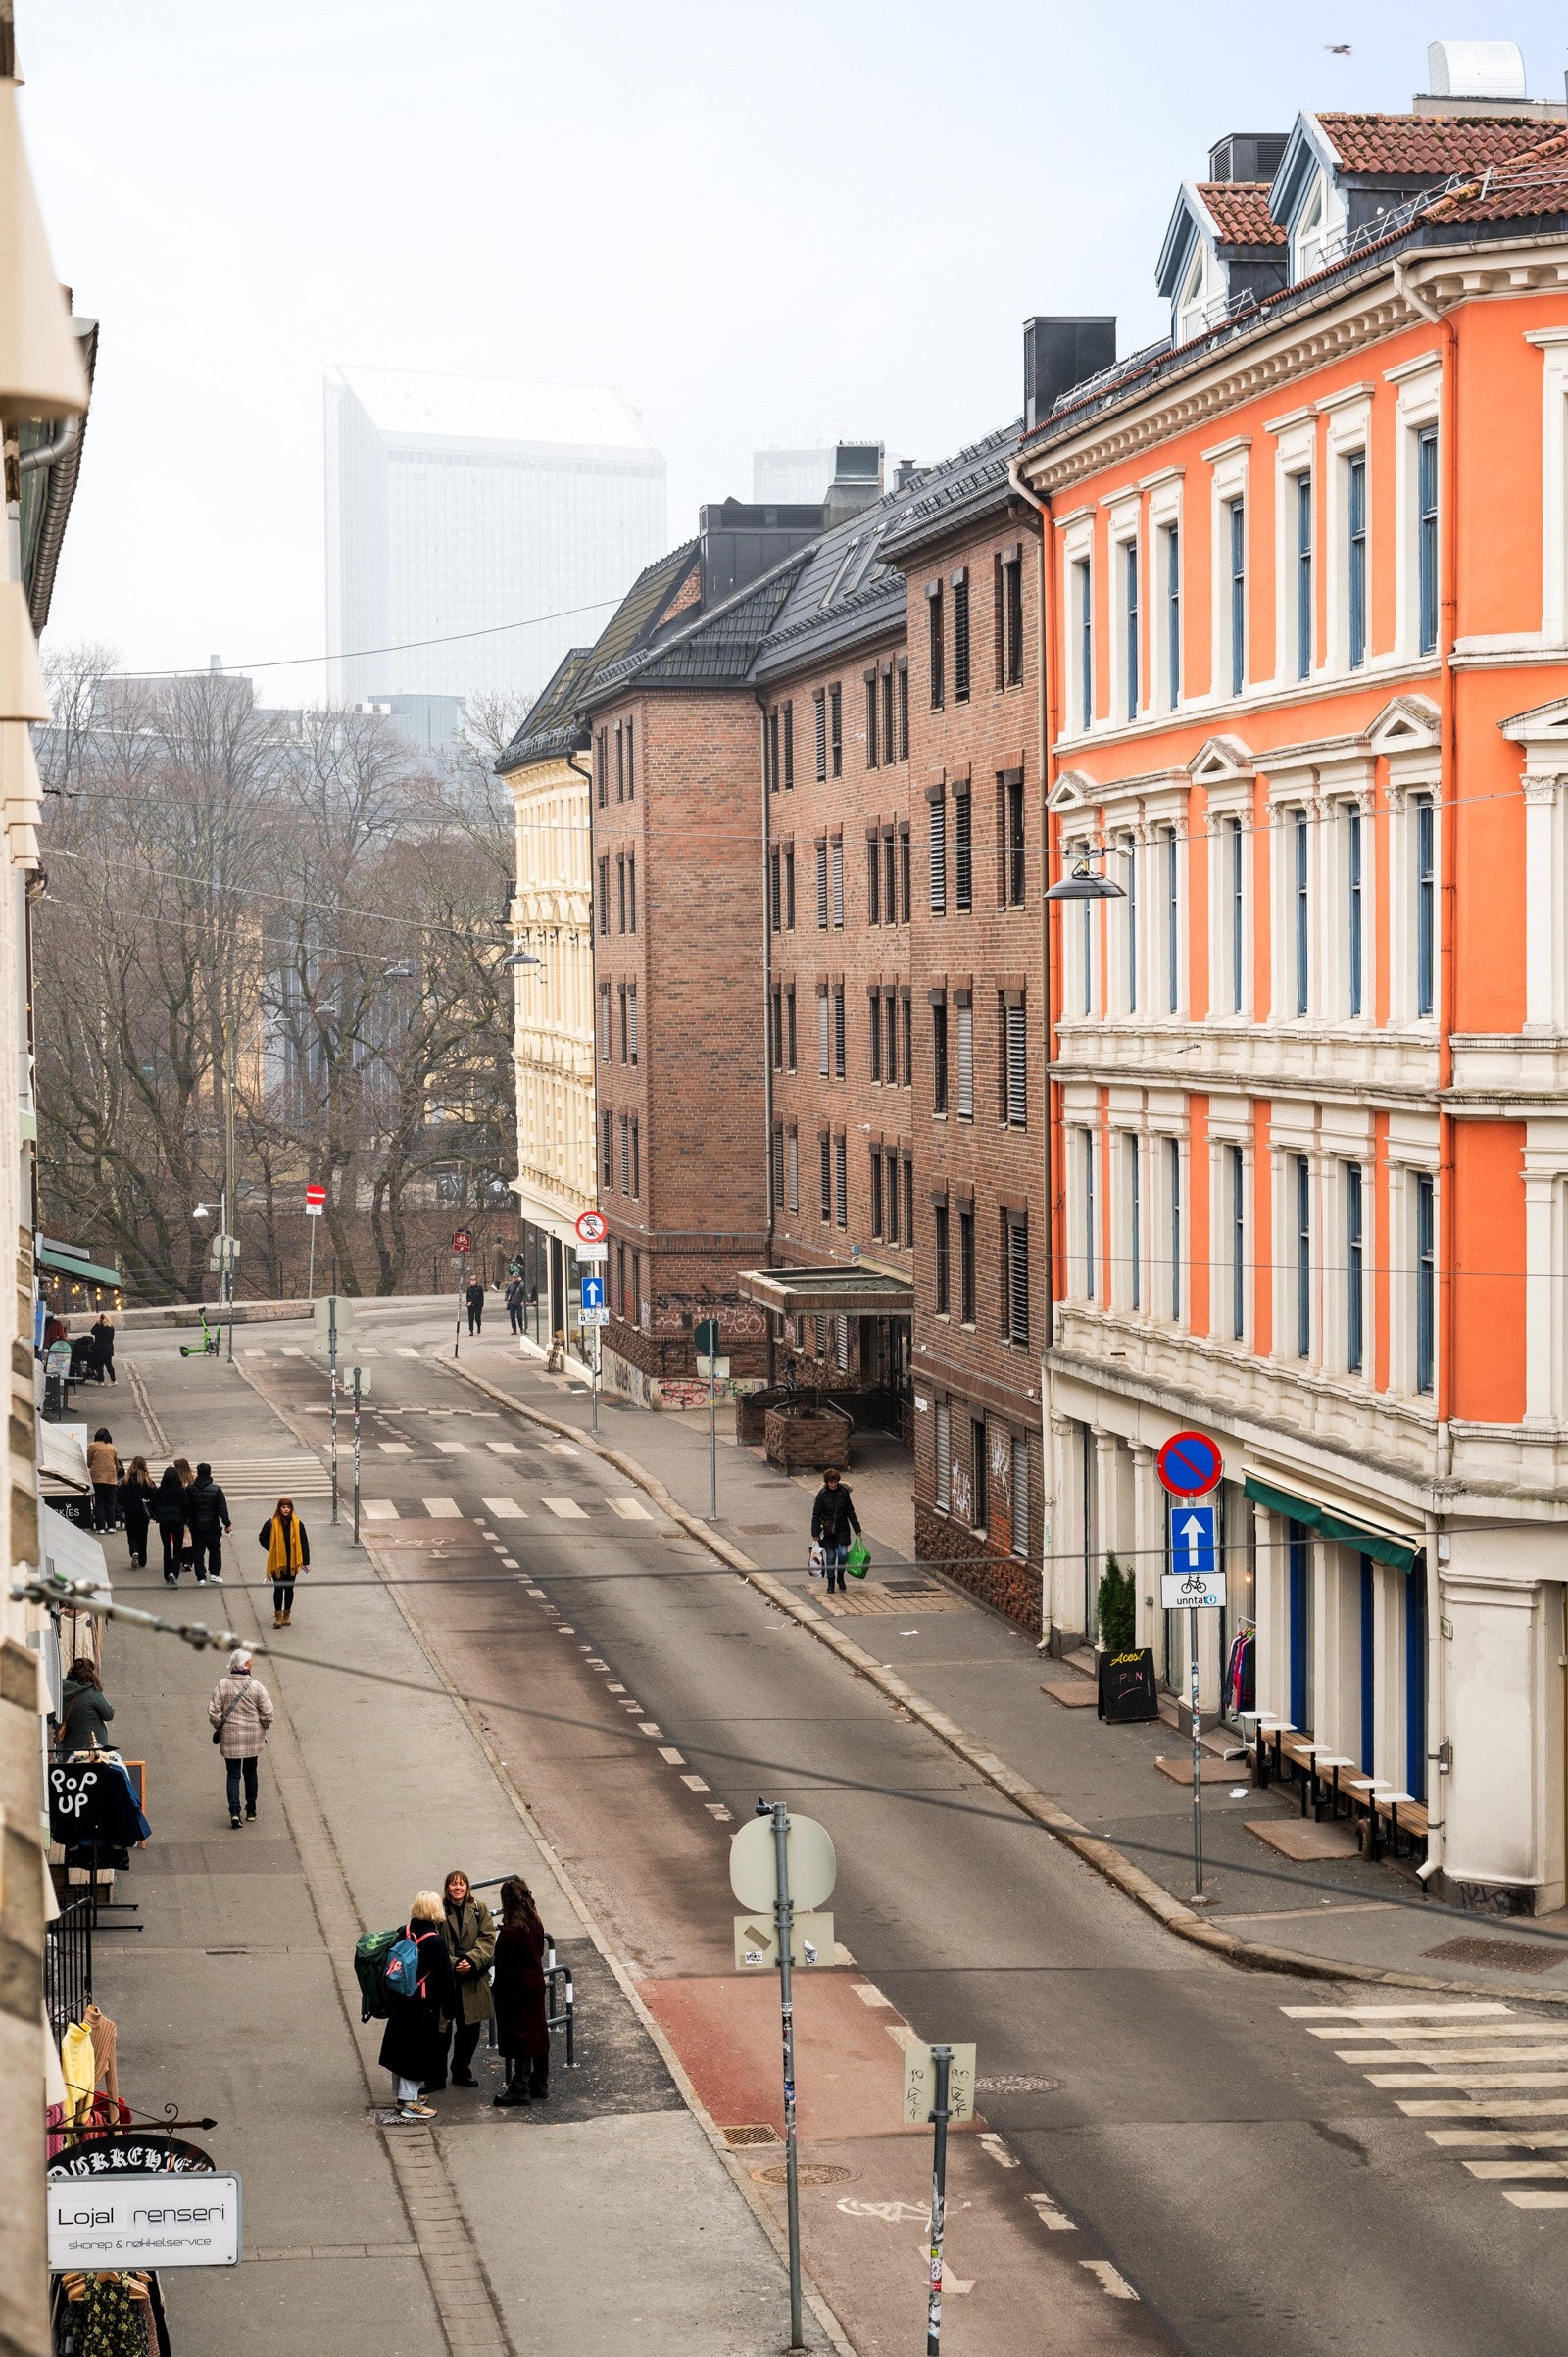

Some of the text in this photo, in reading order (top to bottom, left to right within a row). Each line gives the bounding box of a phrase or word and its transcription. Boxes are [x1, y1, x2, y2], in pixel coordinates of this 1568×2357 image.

[1109, 1650, 1146, 1666] Aces!
[59, 1793, 88, 1817] UP
[58, 2203, 224, 2228] Lojal renseri
[68, 2240, 113, 2251] skorep
[116, 2240, 123, 2249] &
